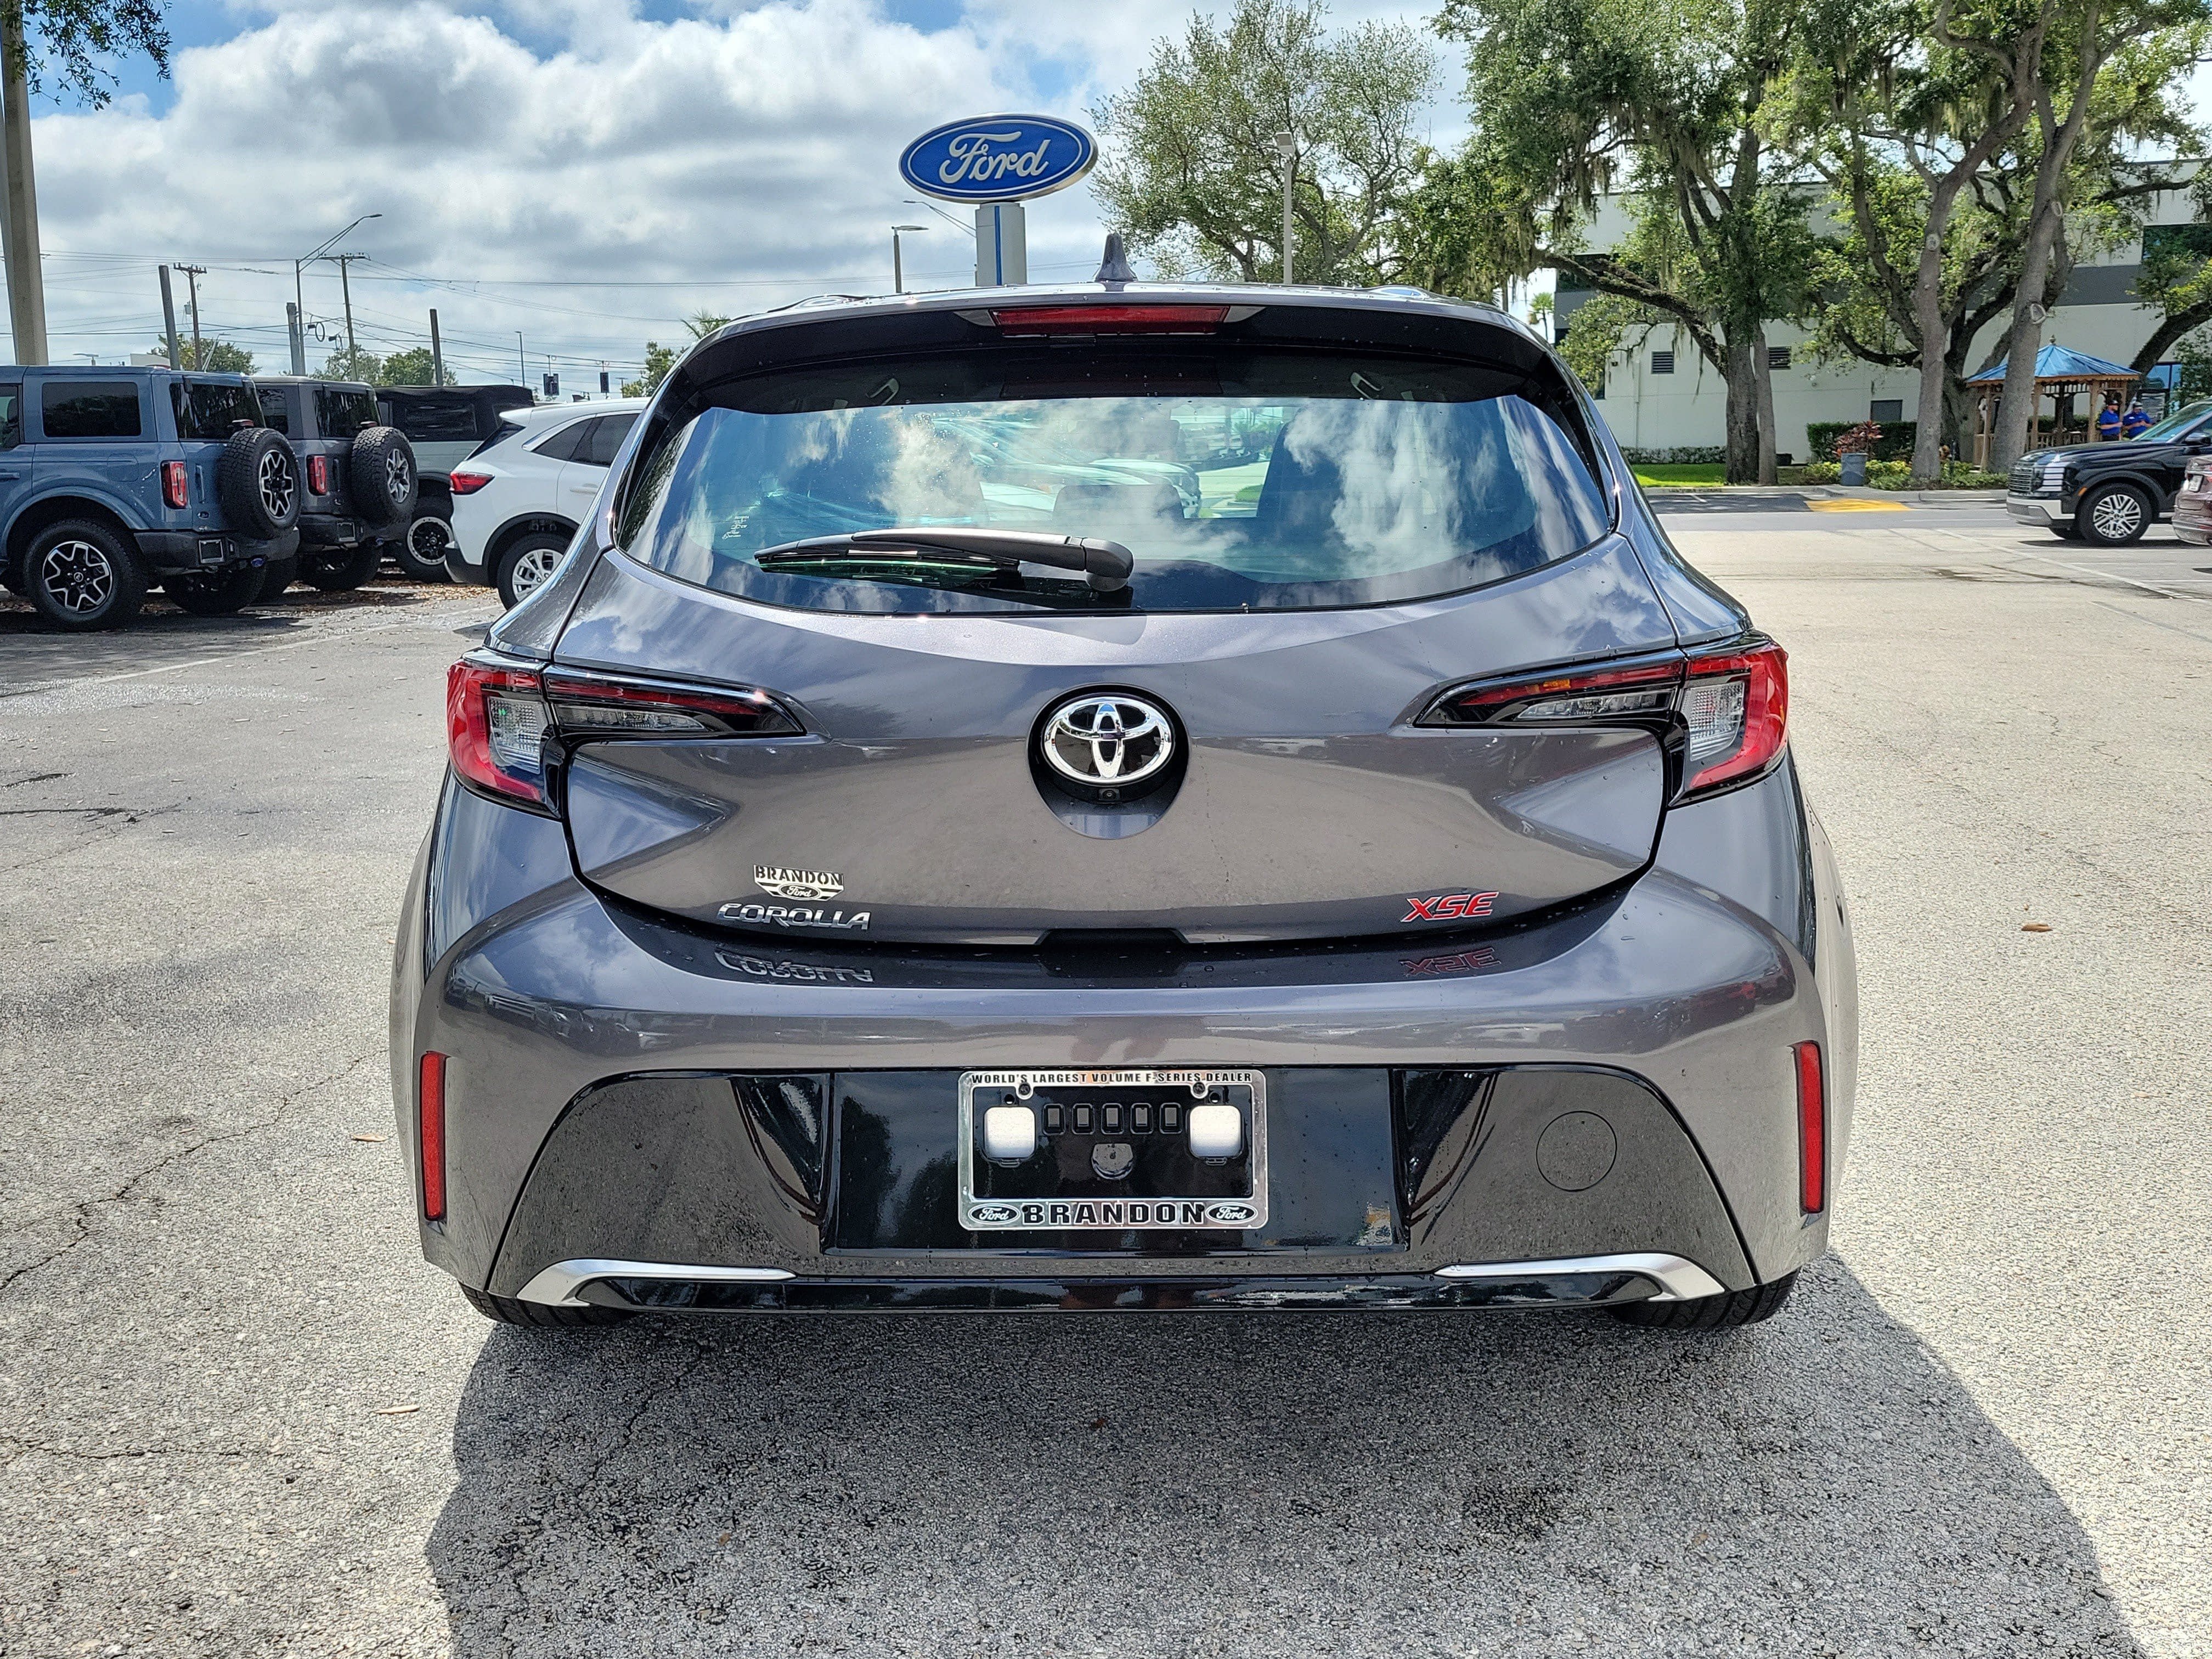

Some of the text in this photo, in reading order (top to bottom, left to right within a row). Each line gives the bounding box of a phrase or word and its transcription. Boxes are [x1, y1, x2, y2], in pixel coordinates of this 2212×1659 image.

[939, 131, 1051, 184] Ford
[754, 865, 843, 886] BRANDON
[786, 885, 812, 898] Ford
[717, 902, 871, 930] COROLLA
[1400, 891, 1499, 922] XSE
[972, 1072, 1252, 1084] WORLD'S LARGEST VOLUME F-SERIES DEALER
[979, 1202, 1247, 1225] Ford BRANDON Ford
